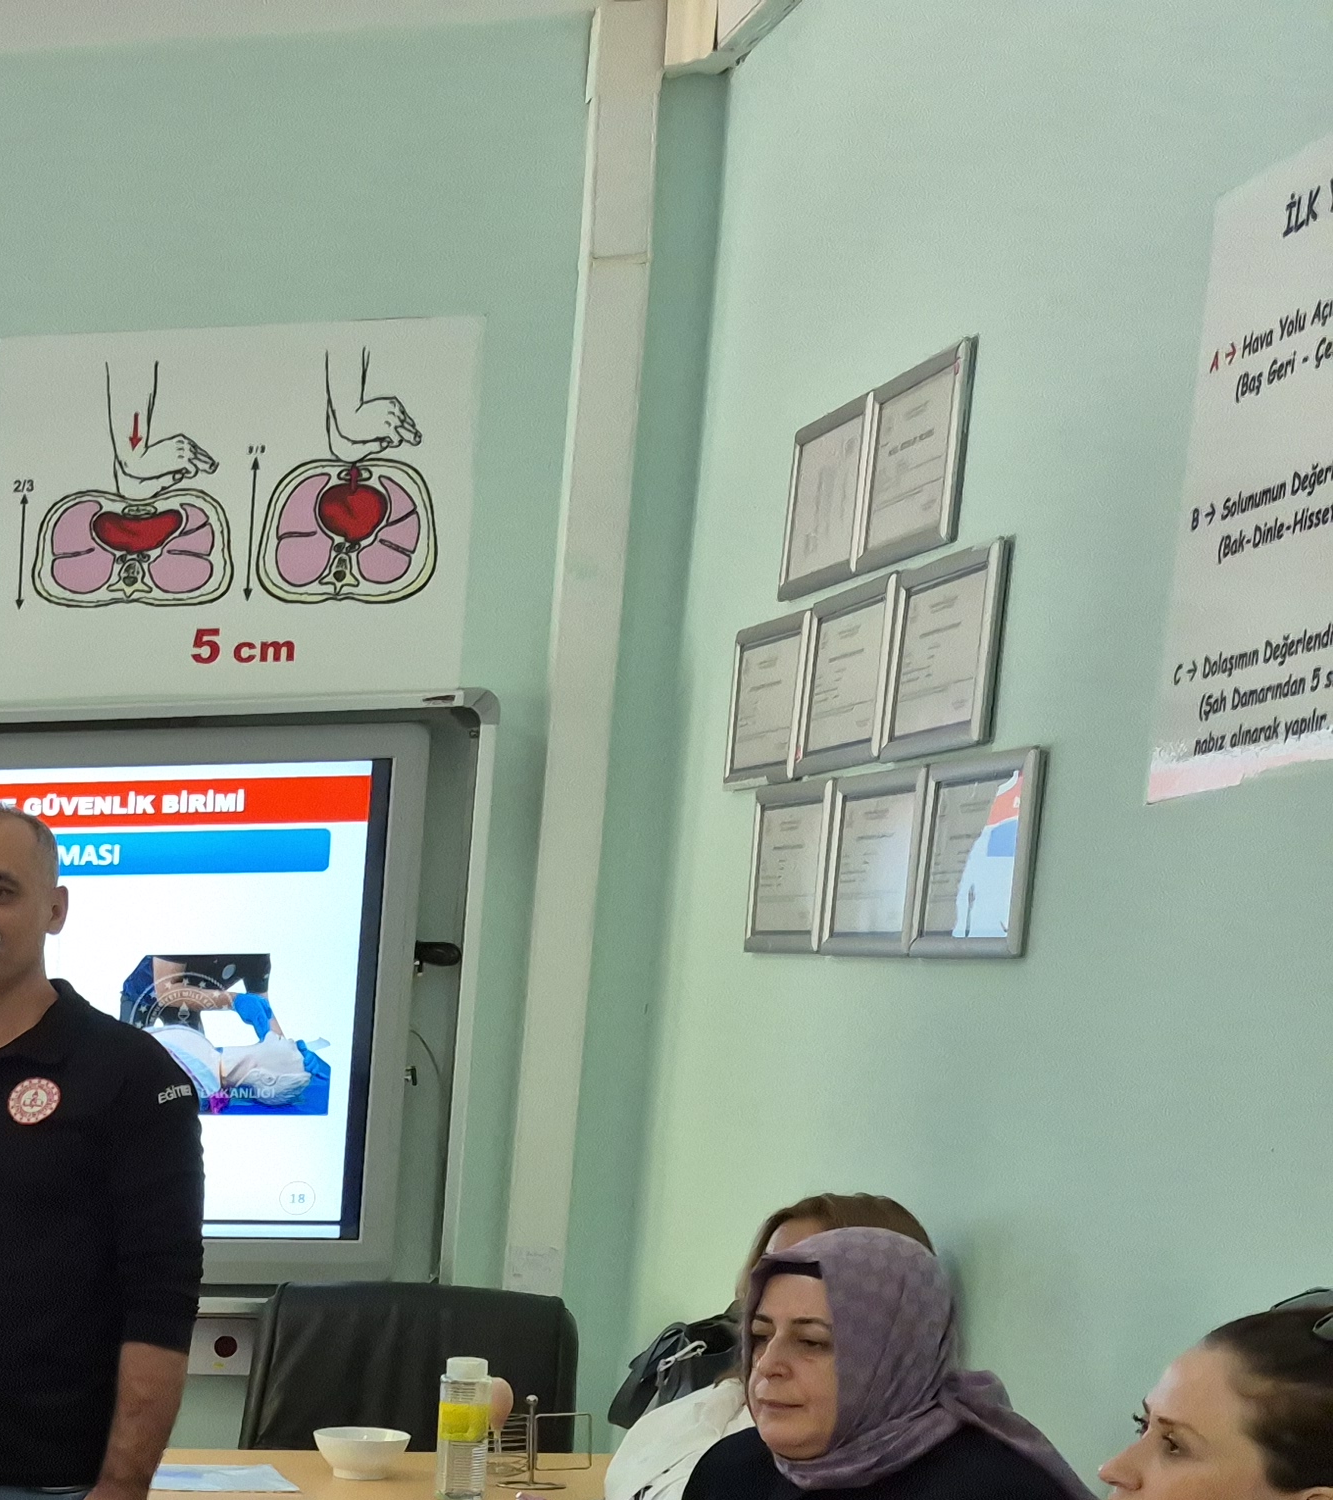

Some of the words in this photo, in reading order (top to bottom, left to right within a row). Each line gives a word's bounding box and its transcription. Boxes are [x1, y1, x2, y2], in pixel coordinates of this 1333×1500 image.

[1283, 185, 1321, 237] İLK
[1209, 349, 1219, 374] A
[1241, 328, 1274, 359] Hava
[1279, 308, 1307, 341] Yolu
[1235, 371, 1263, 403] (Baş
[1267, 350, 1297, 385] Geri
[13, 479, 35, 493] 2/3
[1191, 507, 1200, 532] B
[1221, 480, 1286, 521] Solunumun
[190, 628, 222, 665] 5
[233, 639, 296, 664] cm
[1173, 663, 1184, 686] C
[1202, 651, 1259, 680] Dolaşımın
[1199, 689, 1227, 722] (Şah
[1230, 673, 1306, 711] Damarından
[1310, 667, 1321, 692] 5
[1194, 730, 1226, 757] nabız
[1229, 716, 1281, 748] alınarak
[23, 790, 156, 817] GÜVENLİK
[161, 788, 245, 814] BİRİMİ
[57, 844, 122, 867] MASI
[289, 1193, 306, 1204] 18
